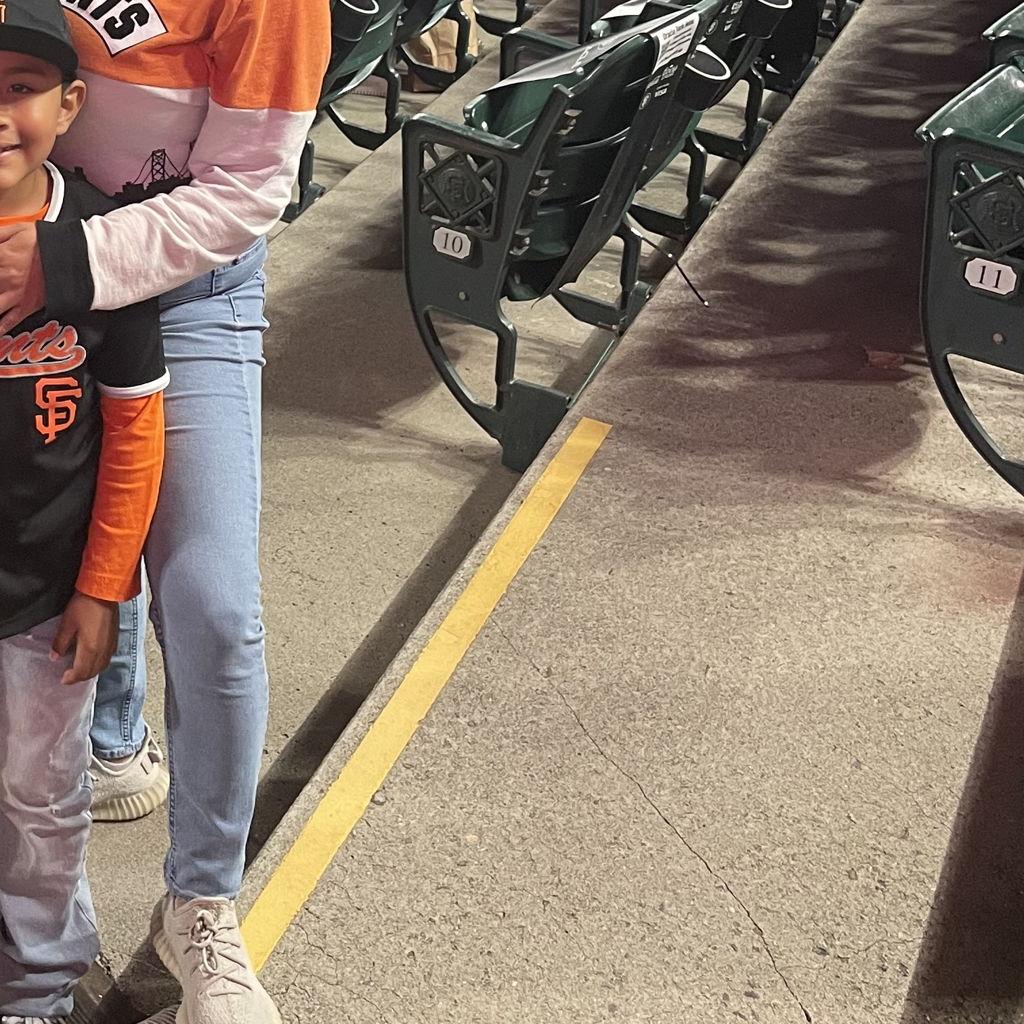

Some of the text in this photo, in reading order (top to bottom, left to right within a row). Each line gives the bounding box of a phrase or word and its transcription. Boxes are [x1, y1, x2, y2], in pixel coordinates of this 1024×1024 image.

[443, 232, 464, 254] 10
[977, 264, 1002, 289] 11
[35, 377, 83, 446] SF
